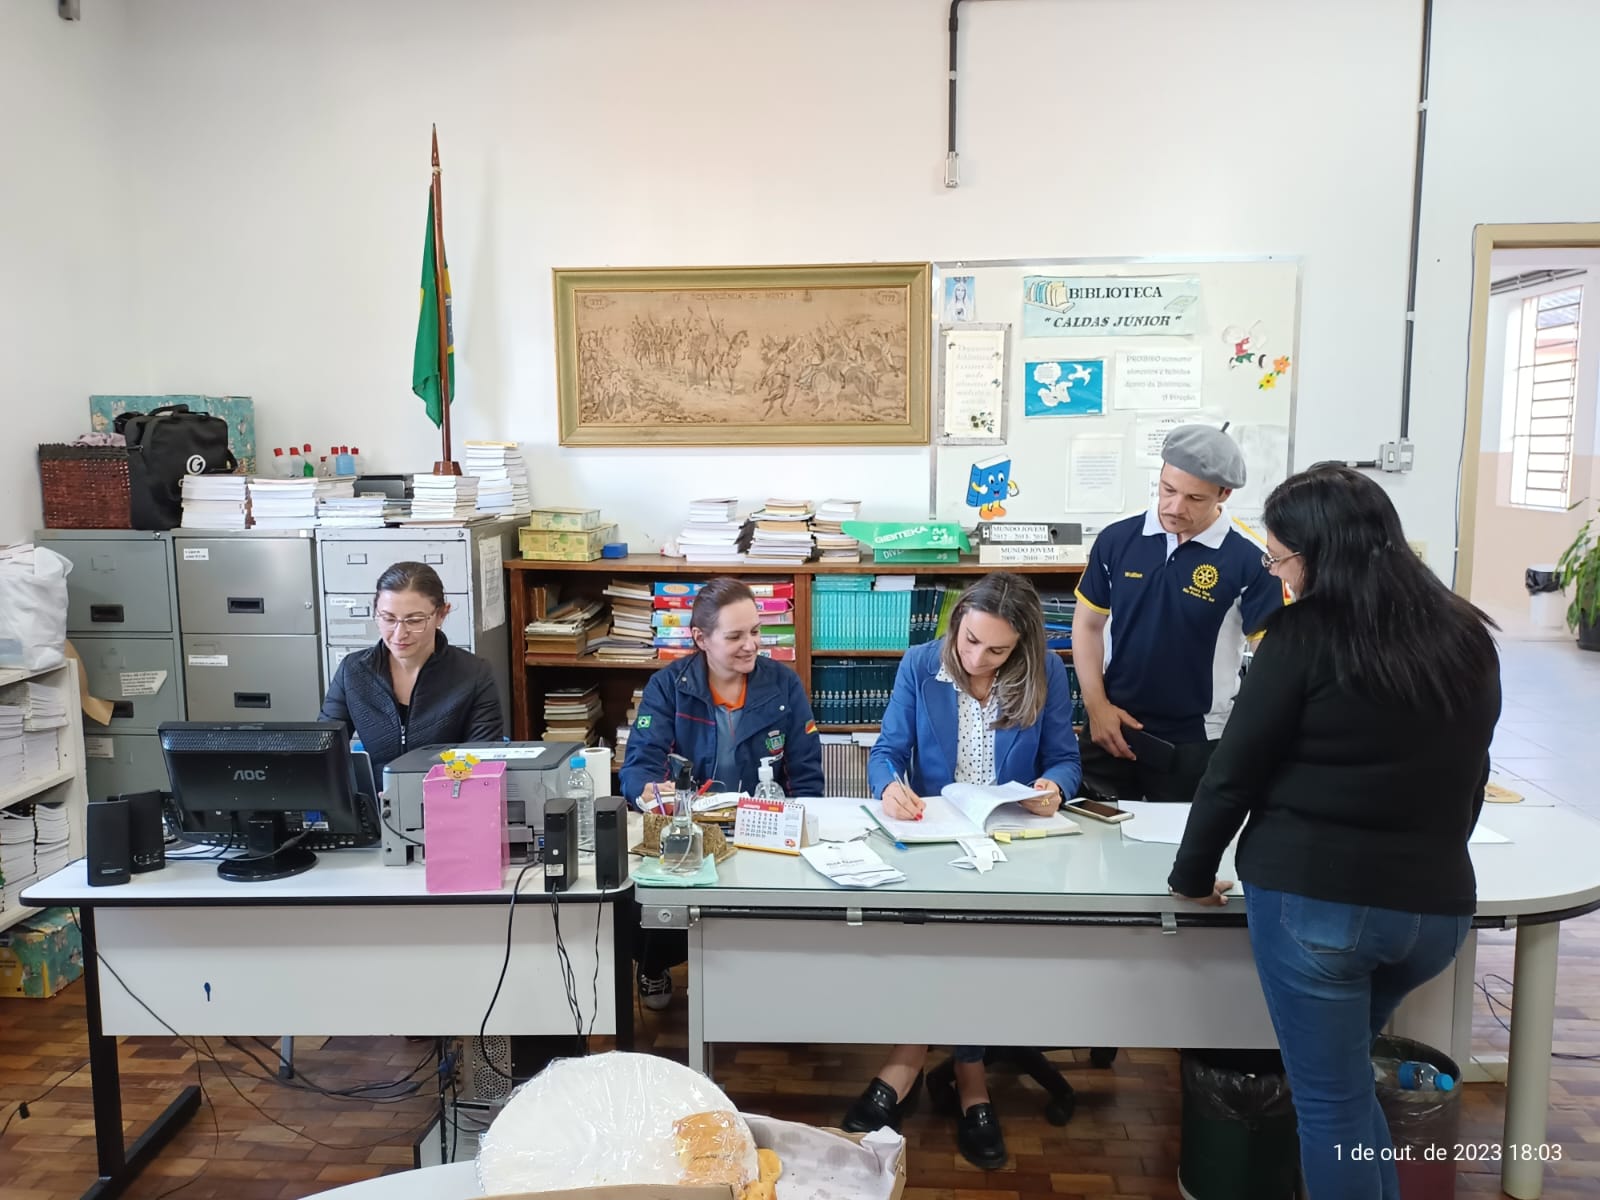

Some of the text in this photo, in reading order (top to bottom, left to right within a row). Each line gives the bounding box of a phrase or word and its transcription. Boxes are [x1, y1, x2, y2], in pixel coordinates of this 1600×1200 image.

[1069, 286, 1163, 299] BIBLIOTECA
[1053, 317, 1109, 328] CALDAS
[874, 526, 928, 544] GIBITEKA
[233, 769, 266, 781] AOC
